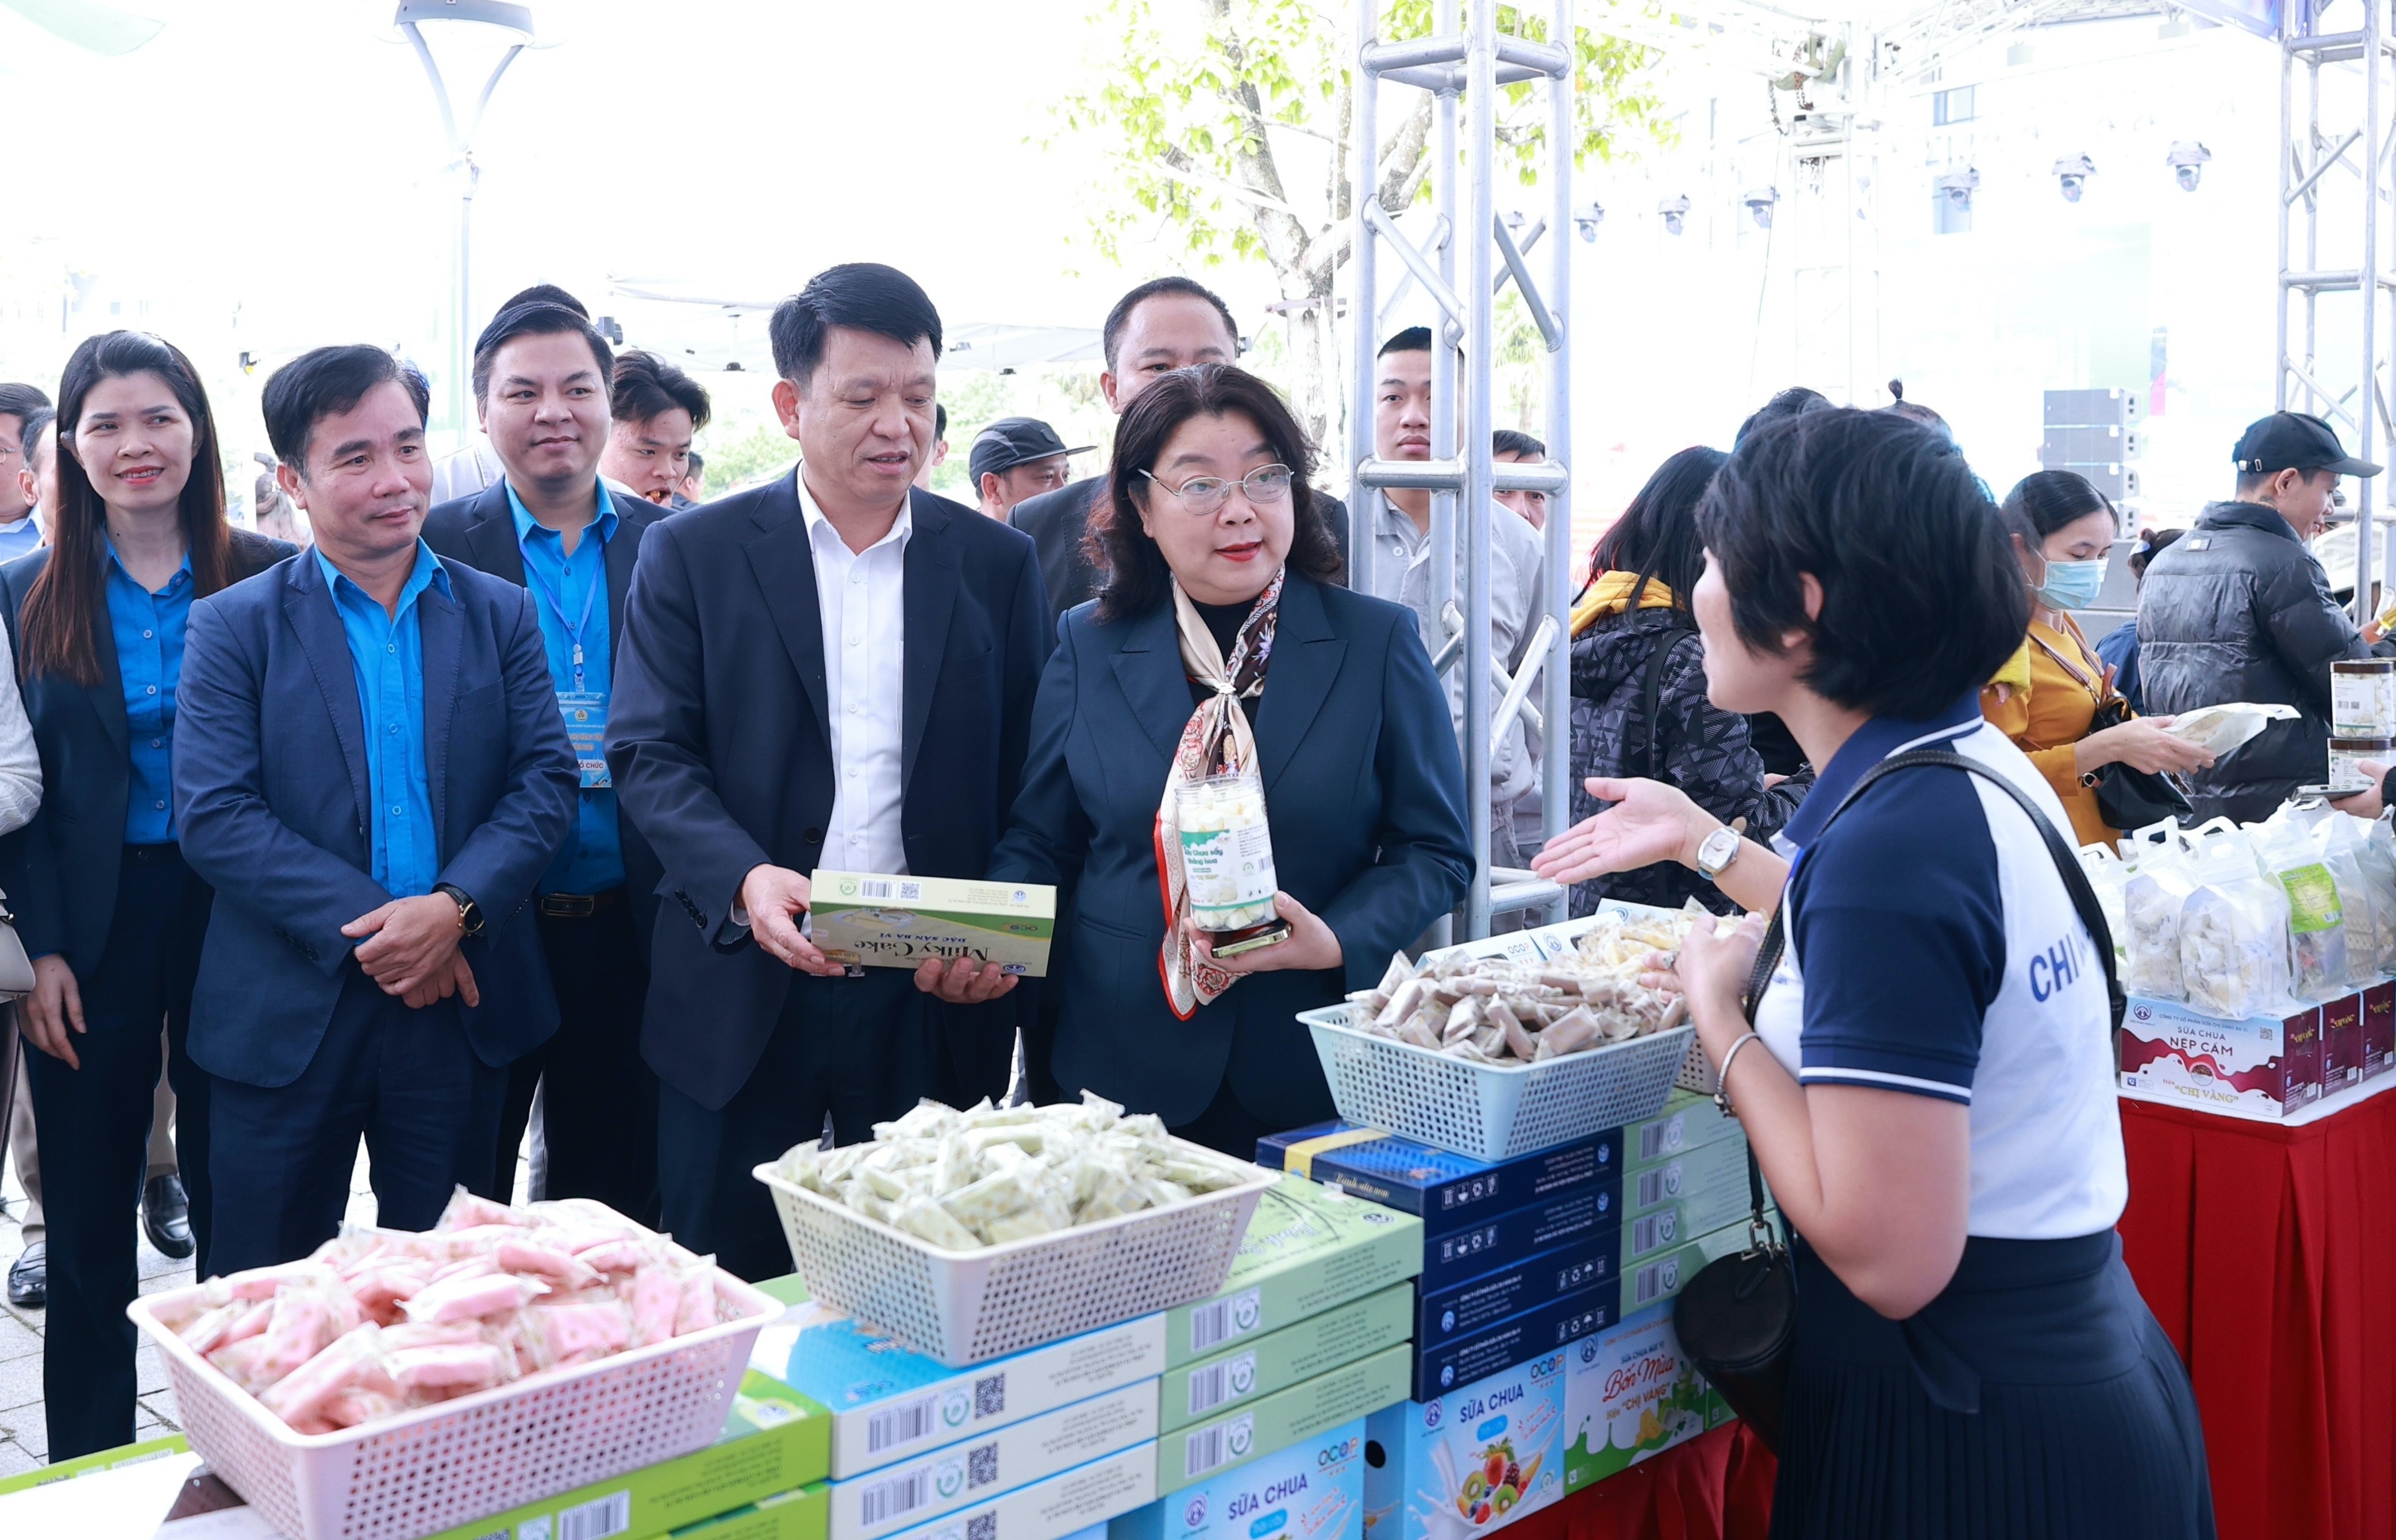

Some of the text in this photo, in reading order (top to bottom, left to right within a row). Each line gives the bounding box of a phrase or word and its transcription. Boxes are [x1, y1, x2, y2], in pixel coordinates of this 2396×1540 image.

[586, 761, 604, 769] CHỨC
[853, 940, 990, 962] Milky Cake
[942, 935, 966, 944] ĐẶC
[1507, 942, 1530, 954] OCOP
[2198, 1030, 2226, 1041] CHUA
[1530, 1354, 1565, 1379] OCOP
[1602, 1354, 1675, 1403] Bốn Mùa
[1460, 1383, 1525, 1423] SỮA CHUA
[1318, 1437, 1360, 1466] OCOP
[1228, 1473, 1309, 1520] SỮA CHUA
